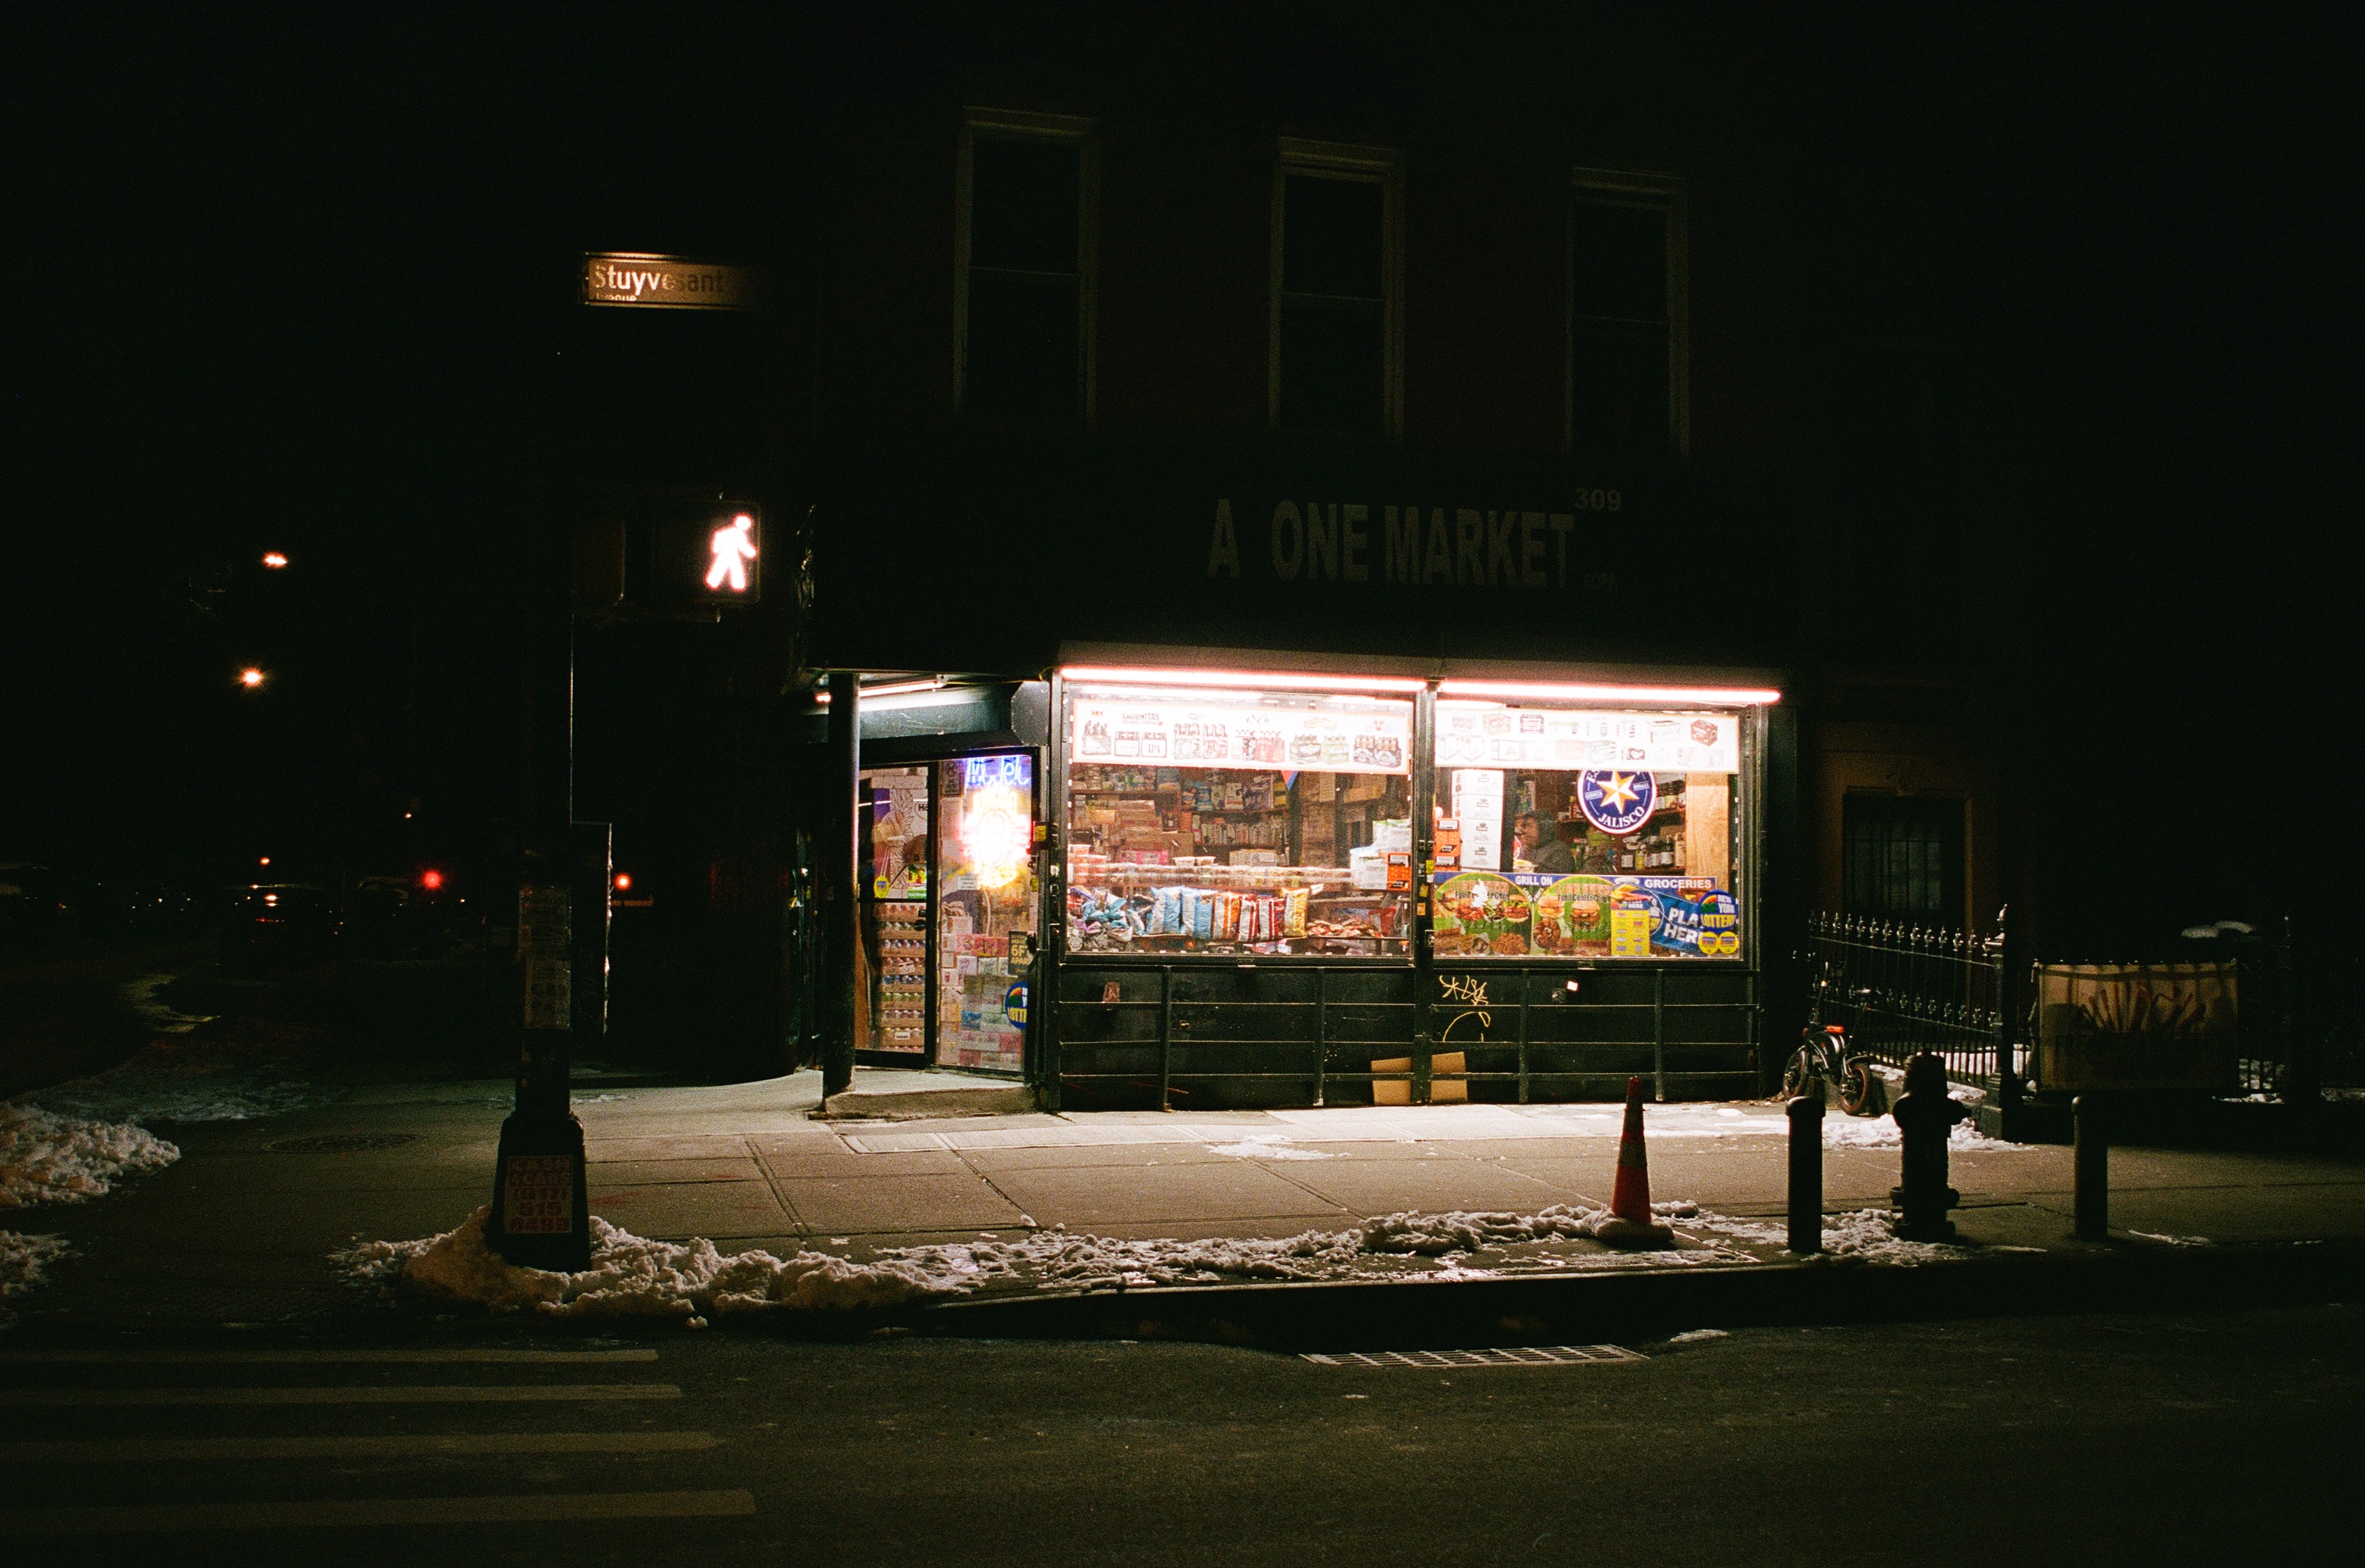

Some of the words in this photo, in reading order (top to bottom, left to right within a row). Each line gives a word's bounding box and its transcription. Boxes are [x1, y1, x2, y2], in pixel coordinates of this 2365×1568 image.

[1574, 487, 1622, 512] 309
[1208, 498, 1241, 580] A
[1270, 499, 1370, 583] ONE
[1383, 504, 1576, 589] MARKET
[1122, 712, 1160, 721] LAGUNITAS
[1598, 806, 1645, 827] JALISCO
[1515, 875, 1539, 886] GRILL
[1540, 876, 1553, 886] ON
[1644, 879, 1712, 889] GROCERIES
[1668, 907, 1704, 929] PLA
[1700, 914, 1736, 929] LOTTERY
